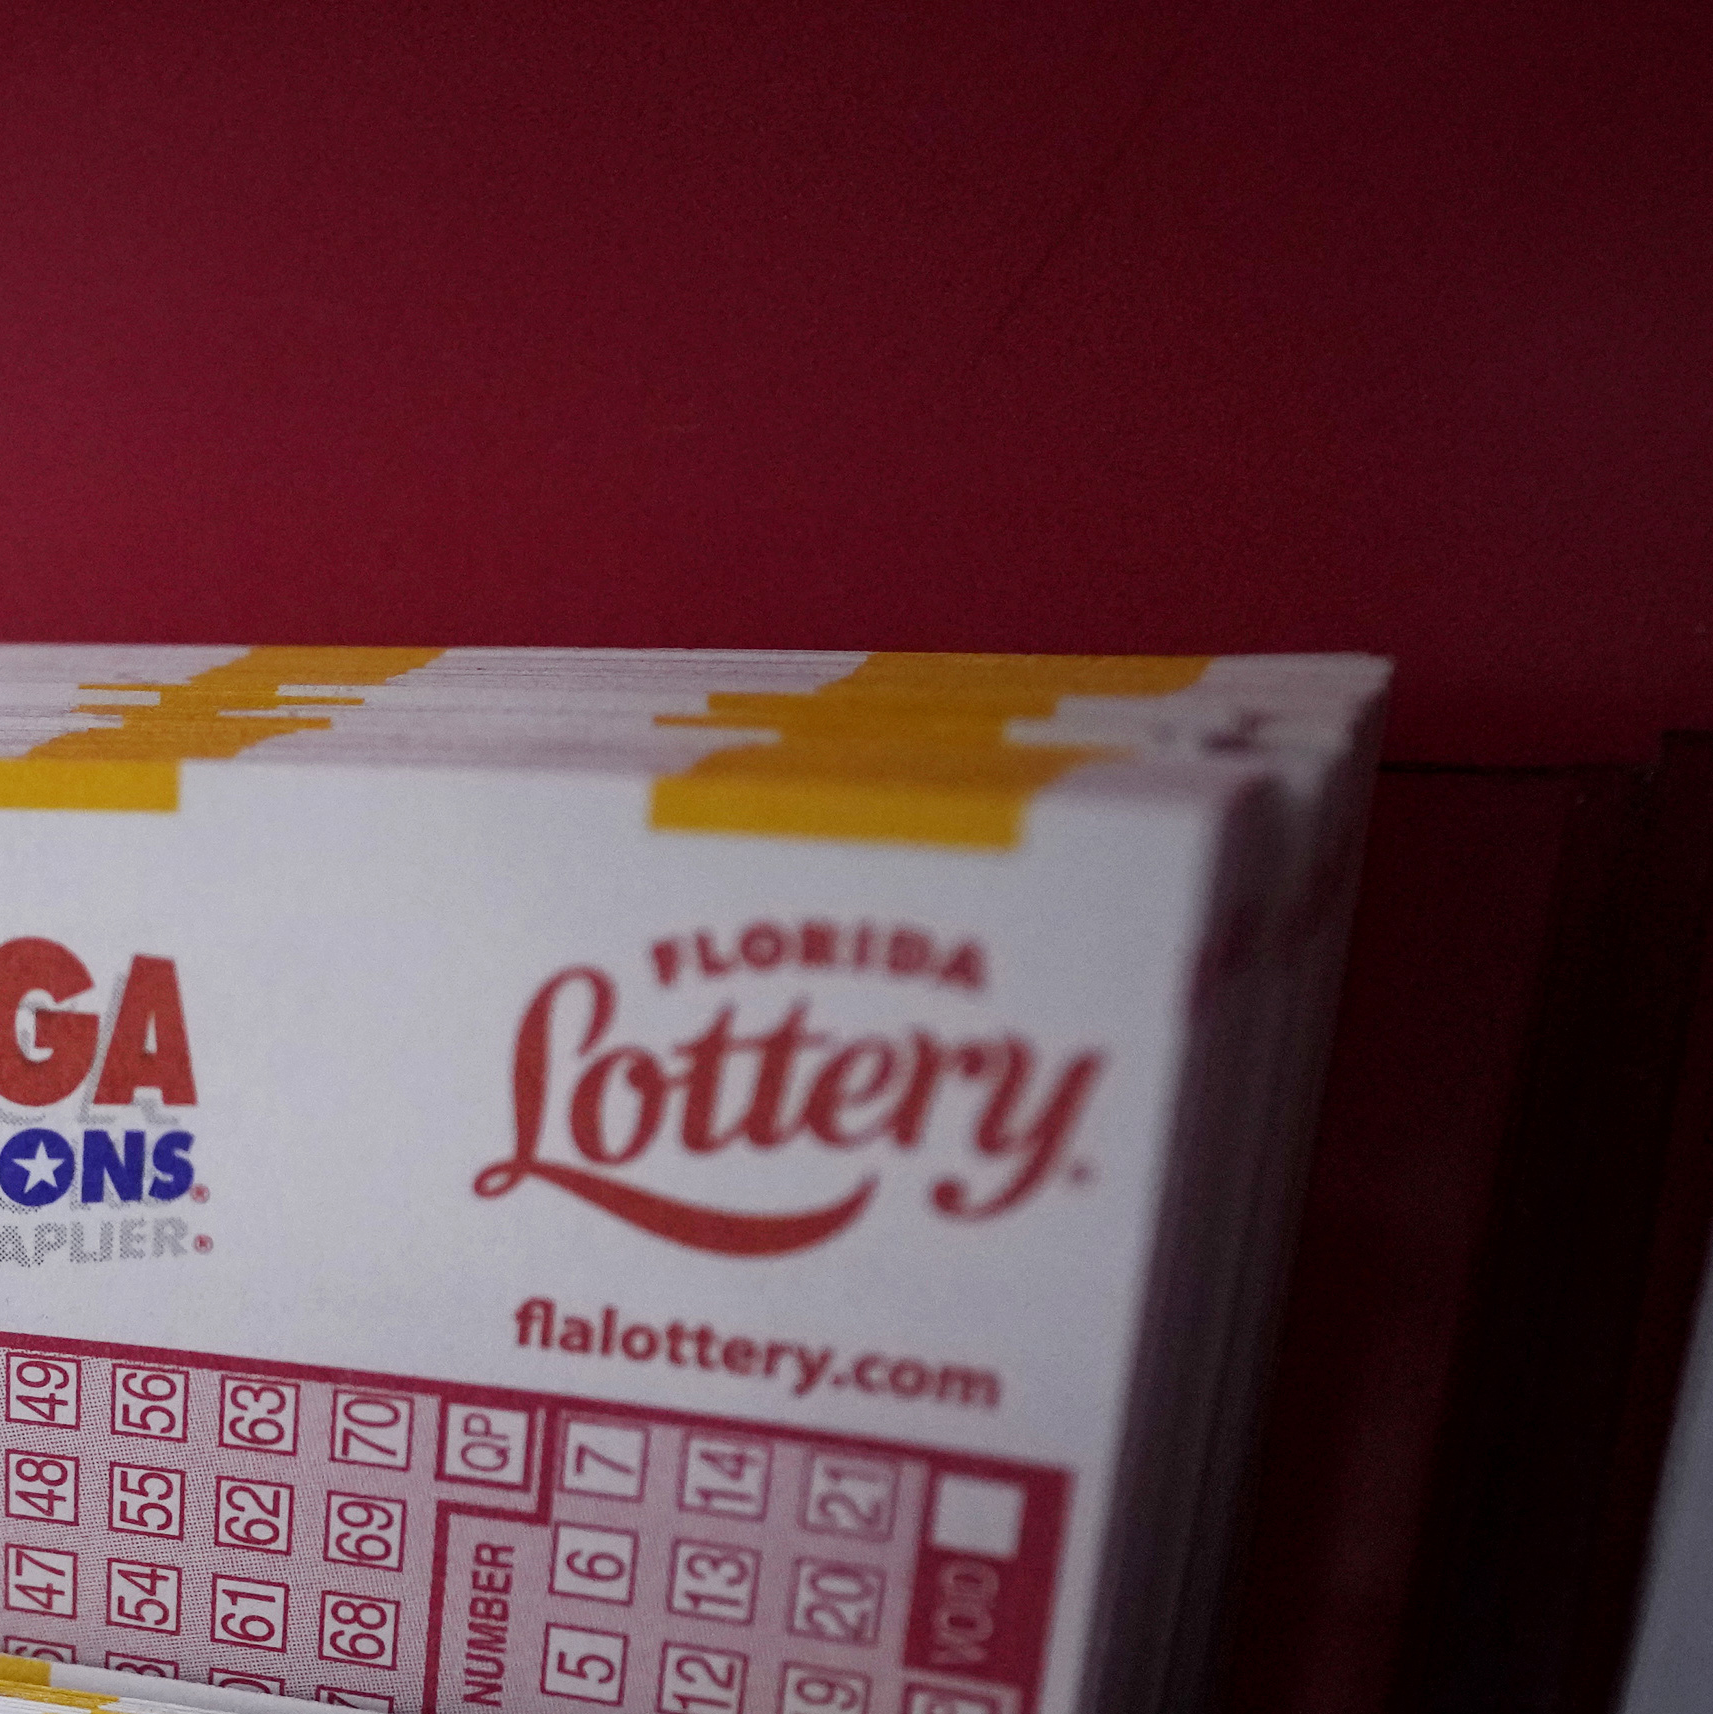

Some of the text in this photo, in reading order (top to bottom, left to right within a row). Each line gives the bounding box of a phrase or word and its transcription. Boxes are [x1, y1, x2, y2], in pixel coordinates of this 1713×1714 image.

[650, 921, 988, 992] FLORIDA
[472, 966, 1109, 1260] Lottery
[513, 1298, 1000, 1408] flalottery.com
[15, 1363, 70, 1417] 49
[121, 1374, 177, 1431] 56
[230, 1387, 287, 1444] 63
[340, 1401, 401, 1457] 70
[15, 1460, 68, 1513] 48
[119, 1472, 174, 1528] 55
[225, 1487, 281, 1543] 62
[817, 1463, 881, 1527] 21
[335, 1502, 394, 1559] 69
[14, 1553, 65, 1606] 47
[462, 1412, 515, 1707] NUMBER QP
[557, 1443, 636, 1685] 5 6 7
[676, 1448, 754, 1712] 12 13 14
[116, 1569, 170, 1623] 54
[221, 1588, 275, 1640] 61
[806, 1566, 869, 1638] 20
[329, 1602, 387, 1658] 68
